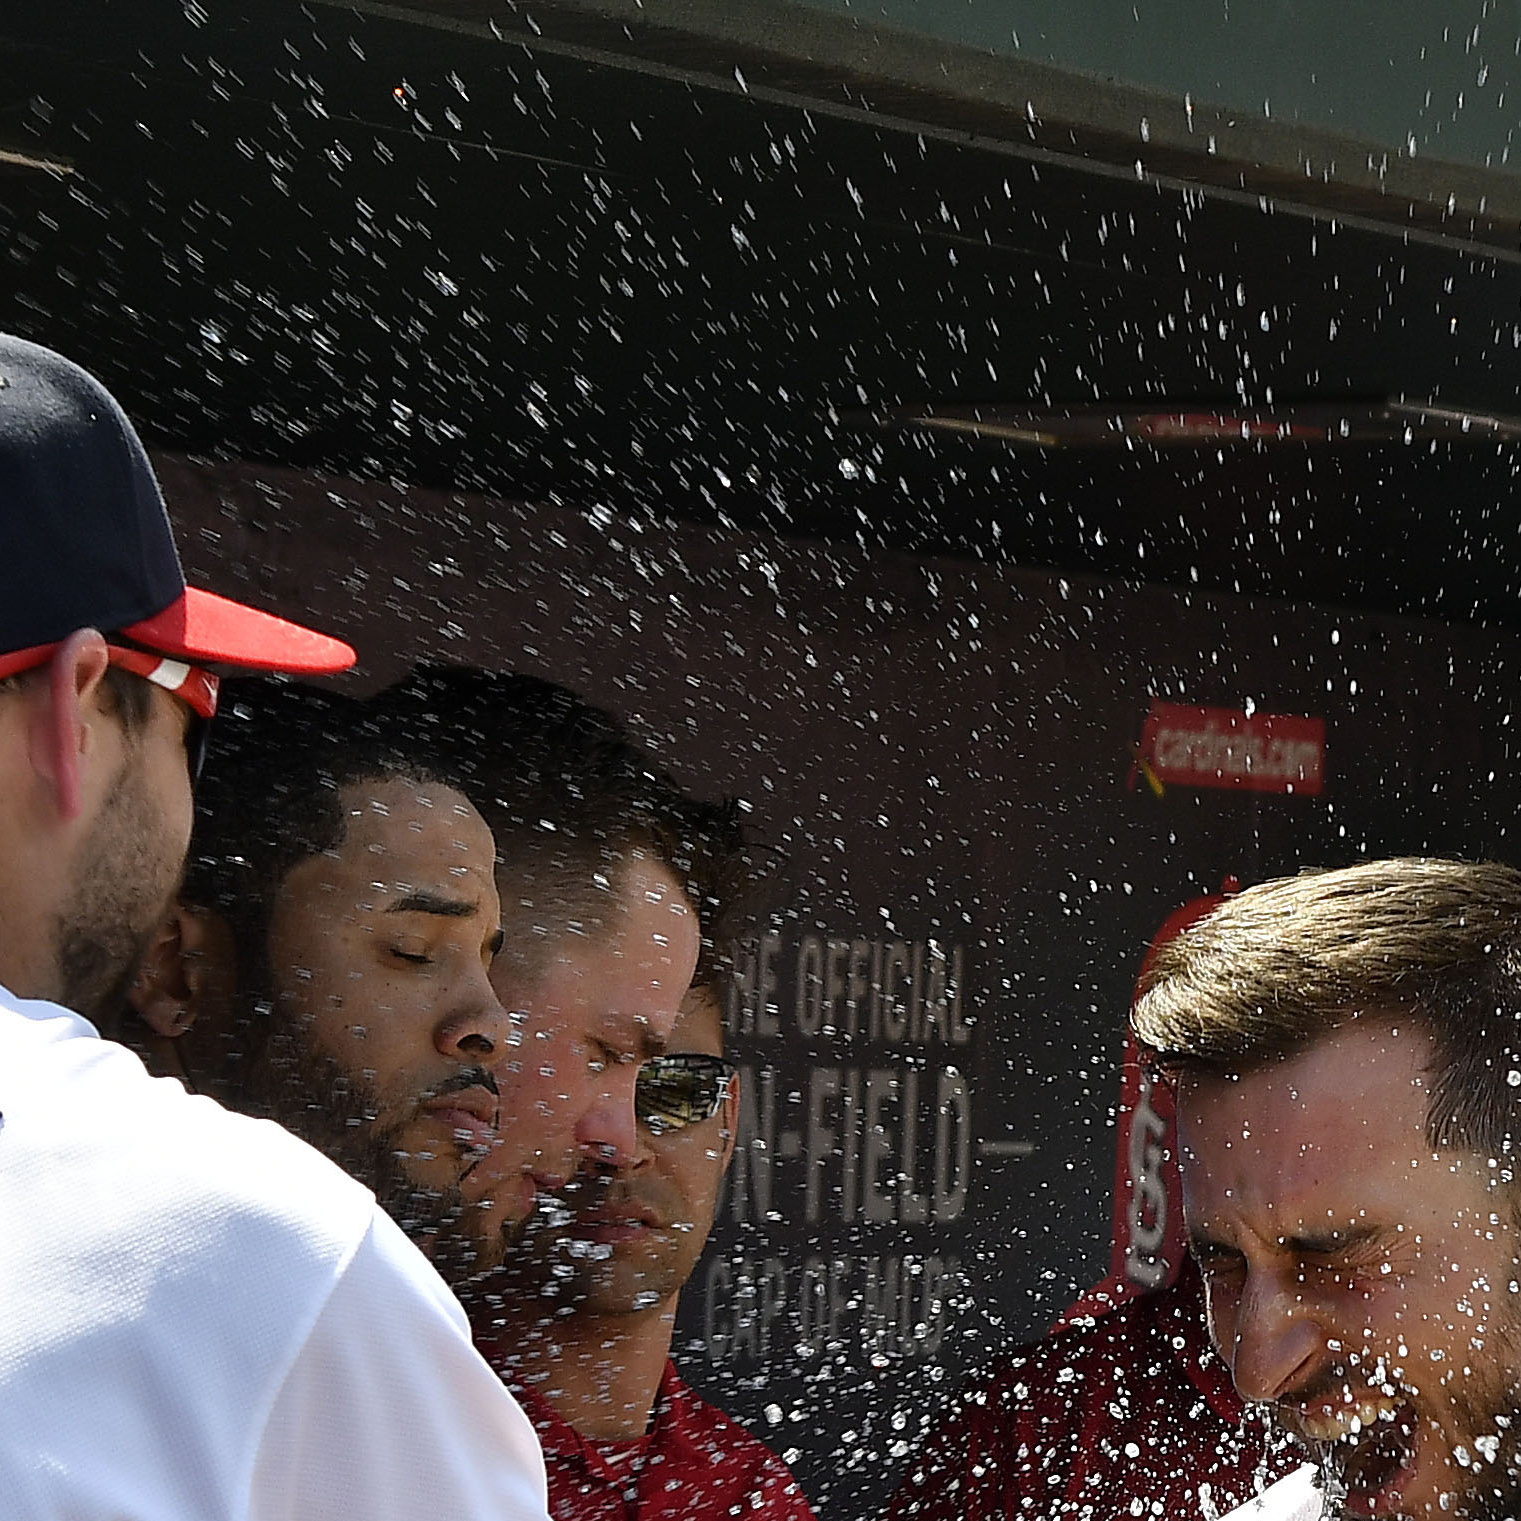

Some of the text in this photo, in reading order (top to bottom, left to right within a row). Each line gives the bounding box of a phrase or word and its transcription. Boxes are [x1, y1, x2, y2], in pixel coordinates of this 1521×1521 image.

[728, 934, 970, 1045] HE OFFICIAL
[724, 1064, 971, 1225] N-FIELD
